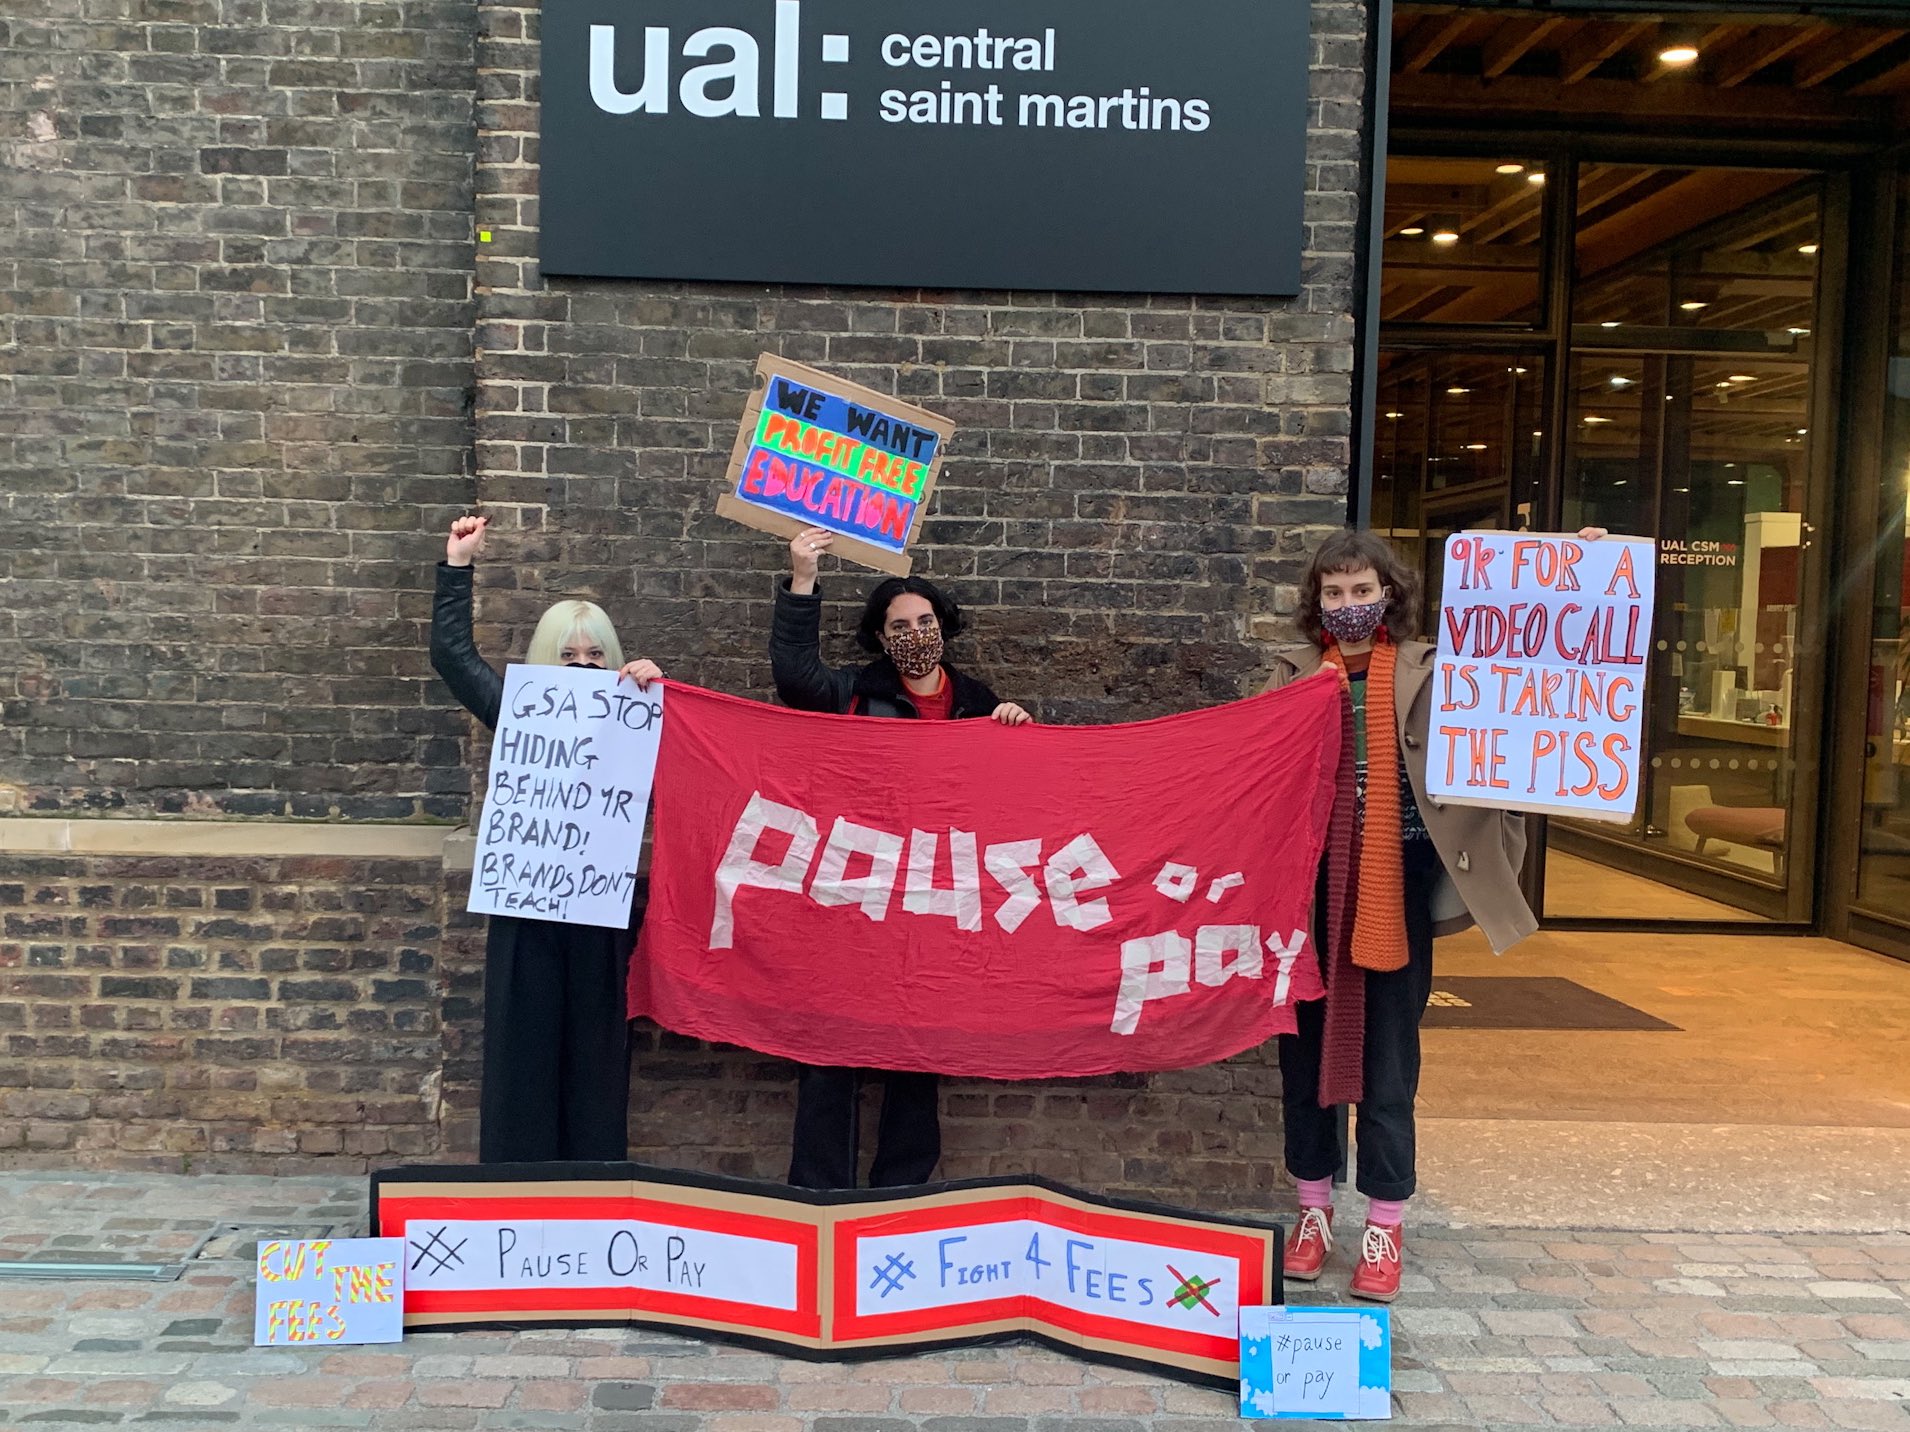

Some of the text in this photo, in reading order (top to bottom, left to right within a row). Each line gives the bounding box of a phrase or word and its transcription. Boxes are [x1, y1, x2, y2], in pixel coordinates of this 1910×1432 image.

[880, 28, 1055, 71] central
[879, 81, 1211, 132] saint martins
[777, 380, 935, 459] WE WANT
[763, 413, 923, 496] PROFIT FREE
[744, 450, 911, 541] EDUCATION
[1660, 553, 1736, 566] RECEPTION
[1661, 540, 1687, 551] UAL
[1691, 541, 1720, 552] CSM
[1511, 540, 1584, 592] FOR
[1604, 545, 1641, 599] A
[1445, 603, 1644, 665] VIDEO CALL
[511, 681, 664, 731] GSA STOP
[1440, 663, 1637, 722] IS TAKING
[500, 727, 599, 770] HIDING
[1440, 726, 1632, 801] THE PISS
[492, 770, 592, 811] BEHIND
[485, 810, 591, 856] BRAND!
[485, 887, 568, 920] TEACH!
[578, 864, 638, 903] DON'T
[1152, 861, 1246, 904] or
[260, 1241, 332, 1282] CUT
[328, 1262, 396, 1304] THE
[939, 1236, 1012, 1288] FIGHT
[1025, 1231, 1051, 1280] 4
[1067, 1239, 1154, 1306] FEES
[268, 1299, 347, 1343] FEES
[1276, 1334, 1343, 1364] #pause
[1276, 1370, 1335, 1400] or pay
